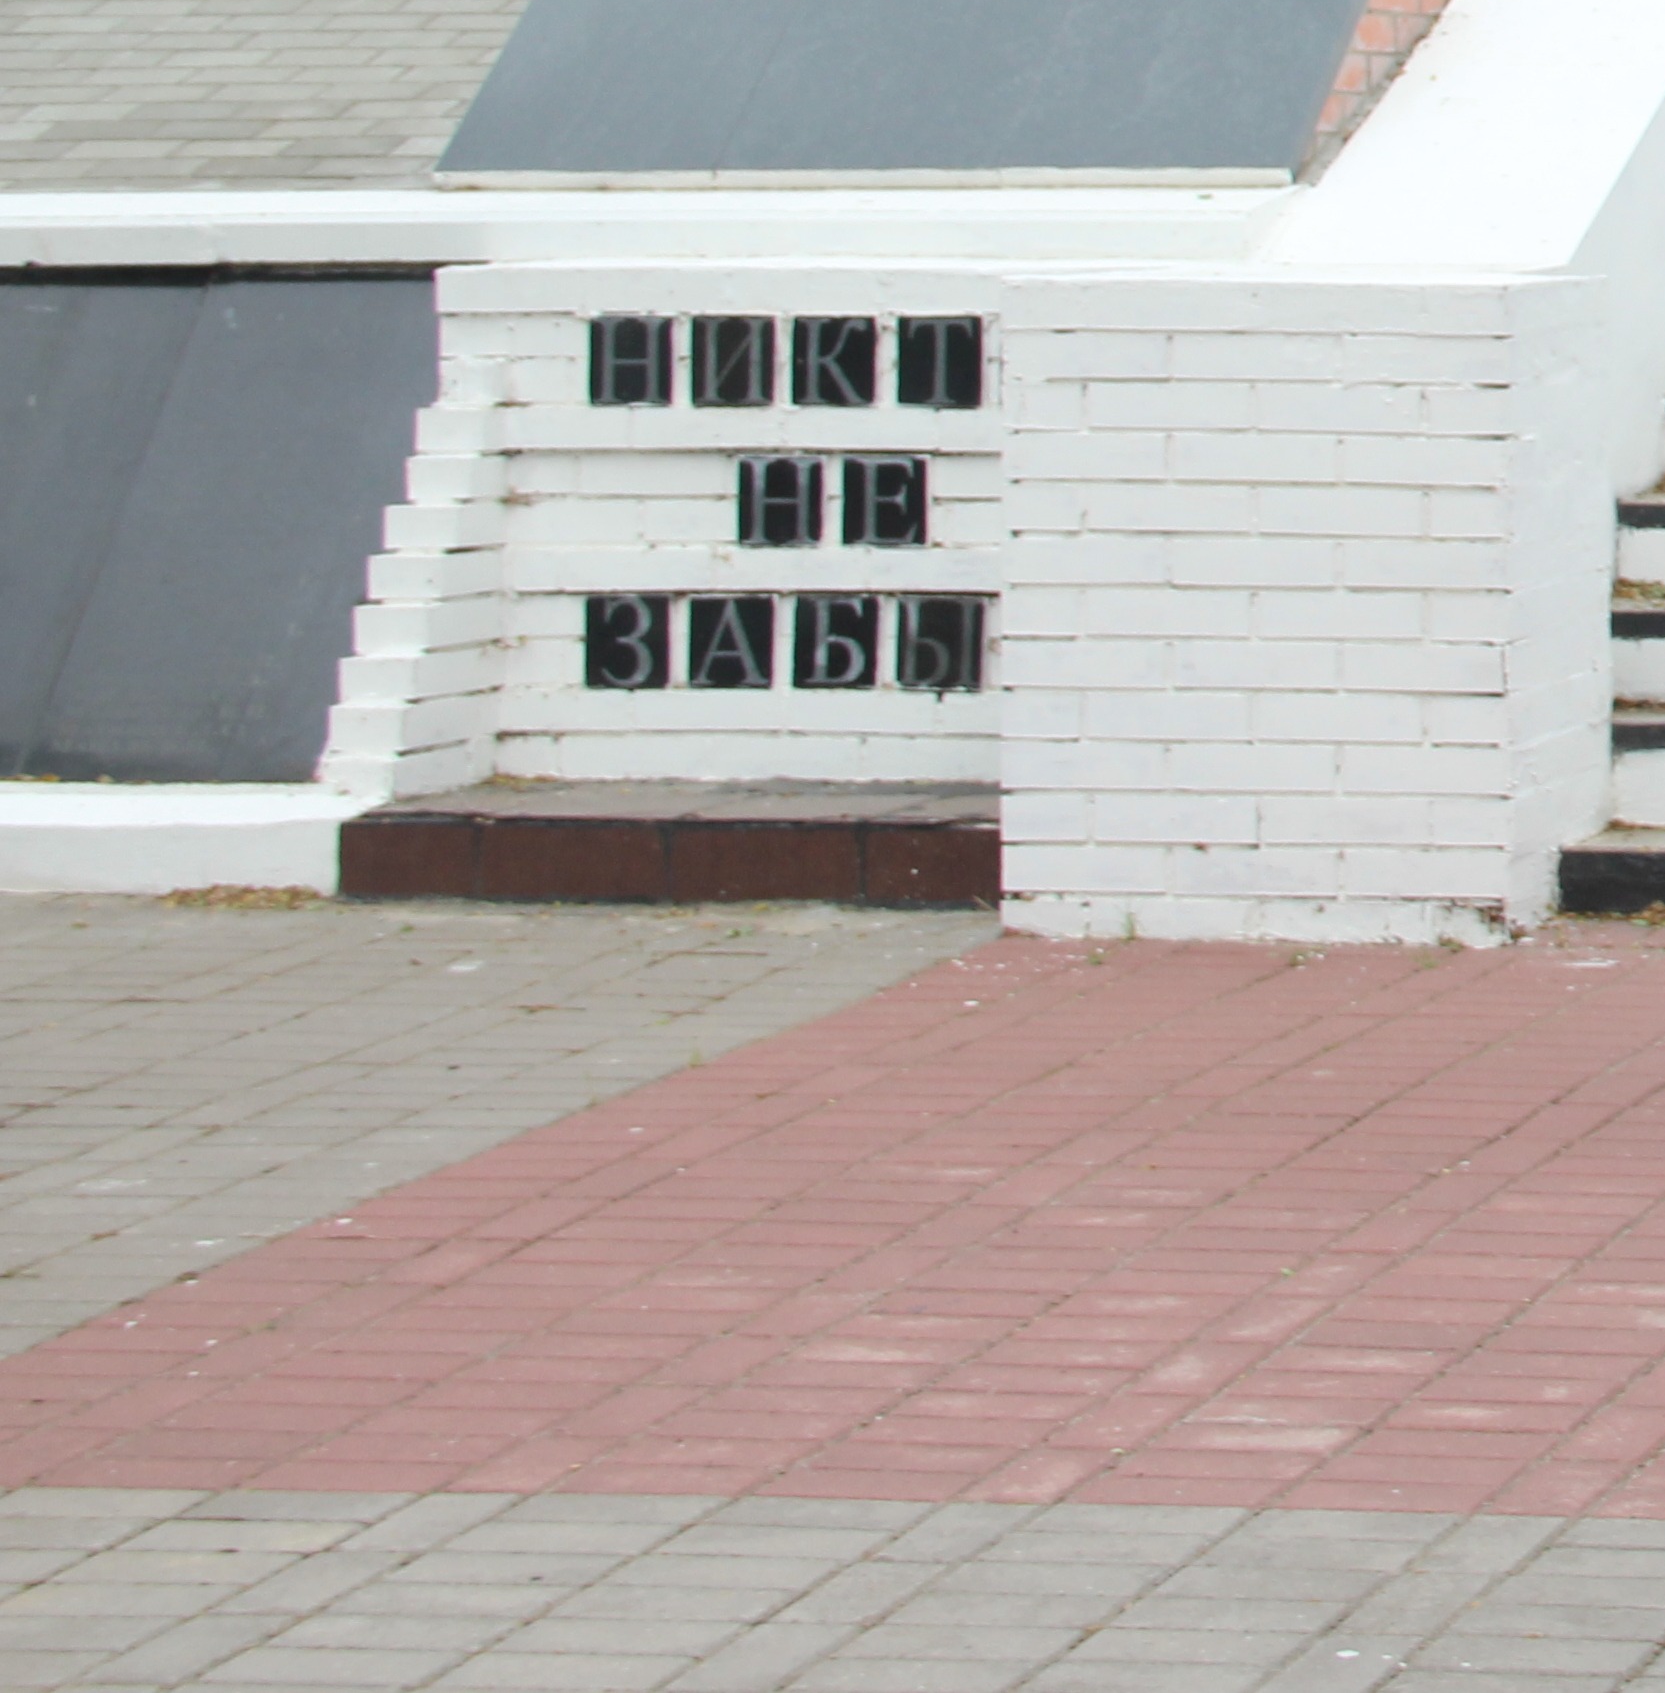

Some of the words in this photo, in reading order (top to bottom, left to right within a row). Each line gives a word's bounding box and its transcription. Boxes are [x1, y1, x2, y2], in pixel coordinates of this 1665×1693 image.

[600, 316, 975, 404] НИКТ
[744, 456, 917, 545] НЕ
[600, 594, 978, 687] ЗАБЫ
